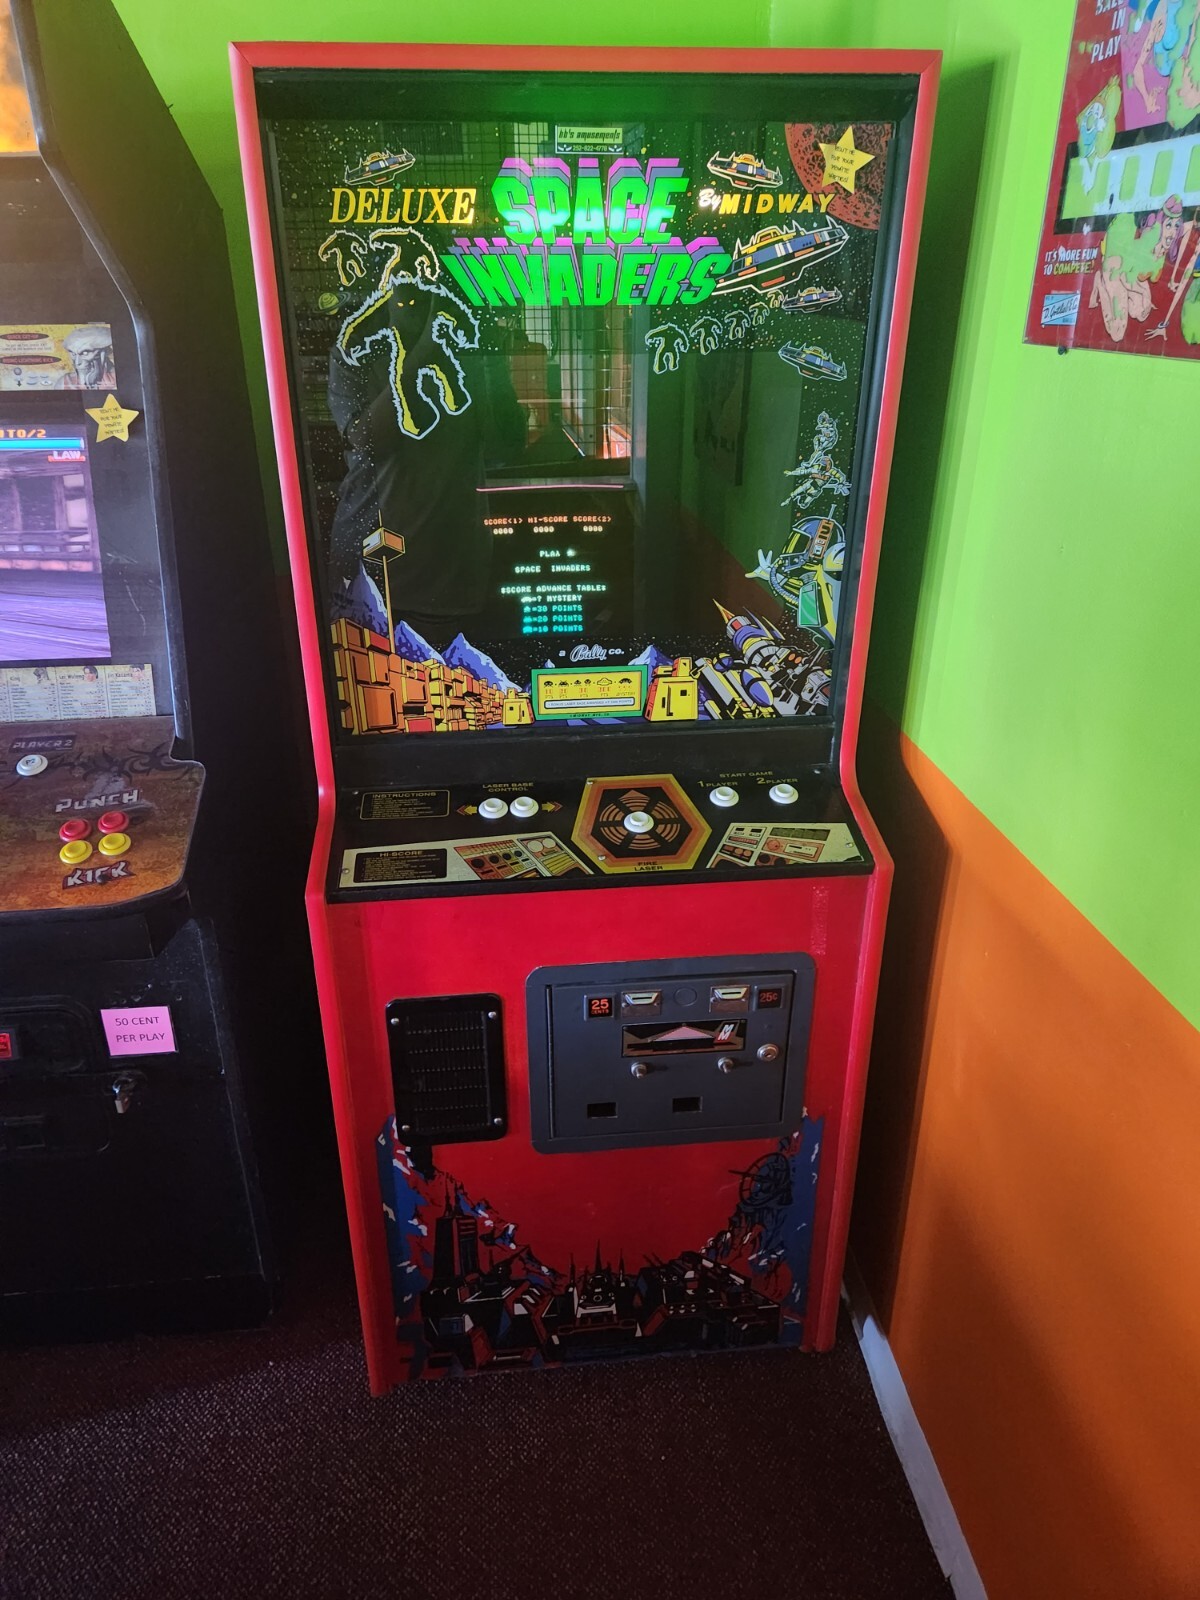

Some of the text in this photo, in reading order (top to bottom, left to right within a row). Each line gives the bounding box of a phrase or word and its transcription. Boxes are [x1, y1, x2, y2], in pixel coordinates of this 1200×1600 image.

[1095, 0, 1125, 16] BA
[1111, 7, 1127, 31] IN
[1090, 34, 1122, 65] PLAY
[329, 187, 477, 224] DELUXE
[490, 159, 690, 245] SPACE
[698, 188, 836, 215] By MIDWAY
[1044, 247, 1099, 262] IT'S MORE FUN
[438, 239, 733, 306] INVADERS
[1043, 260, 1095, 275] TO COMPETE!
[53, 450, 81, 460] LAW
[527, 515, 568, 524] HI-SCORE
[493, 527, 514, 535] 0000
[514, 564, 591, 573] SPACE INVADERS
[536, 584, 572, 592] ADVANCE
[569, 643, 607, 662] Bally
[12, 739, 73, 749] PLAYER 2
[697, 780, 705, 788] 1
[756, 777, 766, 785] 2
[55, 789, 140, 813] PUNCH
[67, 861, 129, 887] KICK
[591, 998, 609, 1010] 25
[115, 1016, 160, 1026] 50 CENT
[116, 1032, 165, 1043] PER PLAY
